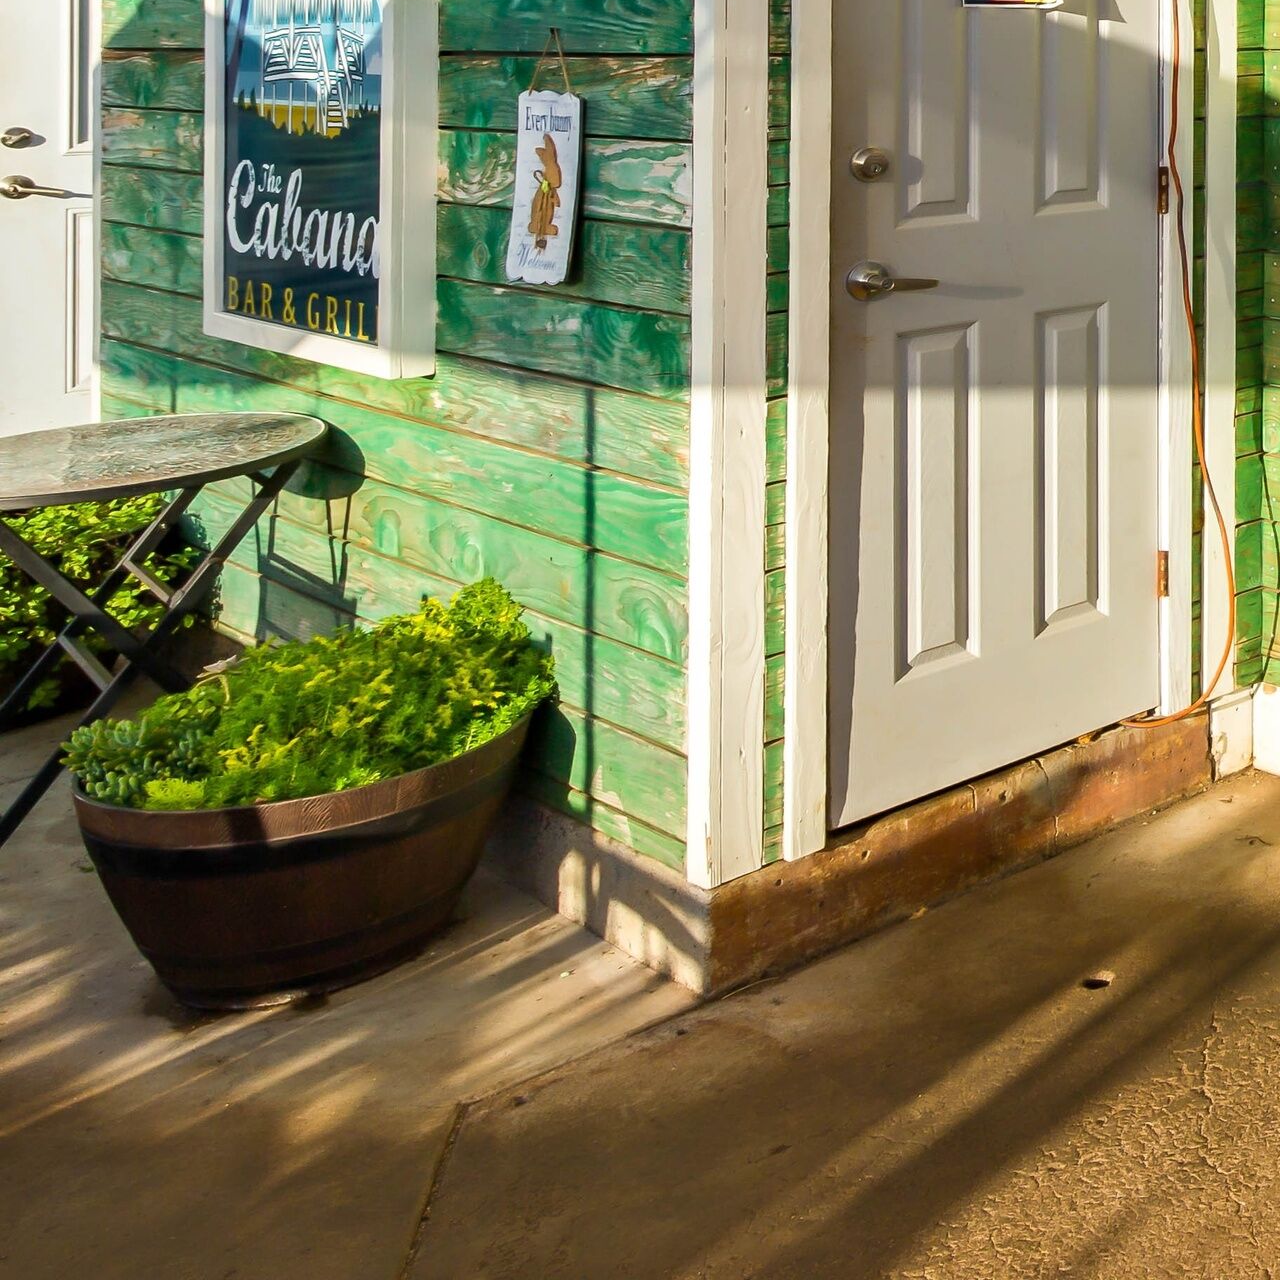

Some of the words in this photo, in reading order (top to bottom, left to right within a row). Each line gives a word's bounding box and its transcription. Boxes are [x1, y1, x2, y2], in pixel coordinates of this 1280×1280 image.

[257, 163, 282, 194] The
[227, 159, 381, 279] Cabana
[227, 276, 273, 320] BAR
[282, 287, 296, 325] &
[307, 292, 373, 340] GRIL
